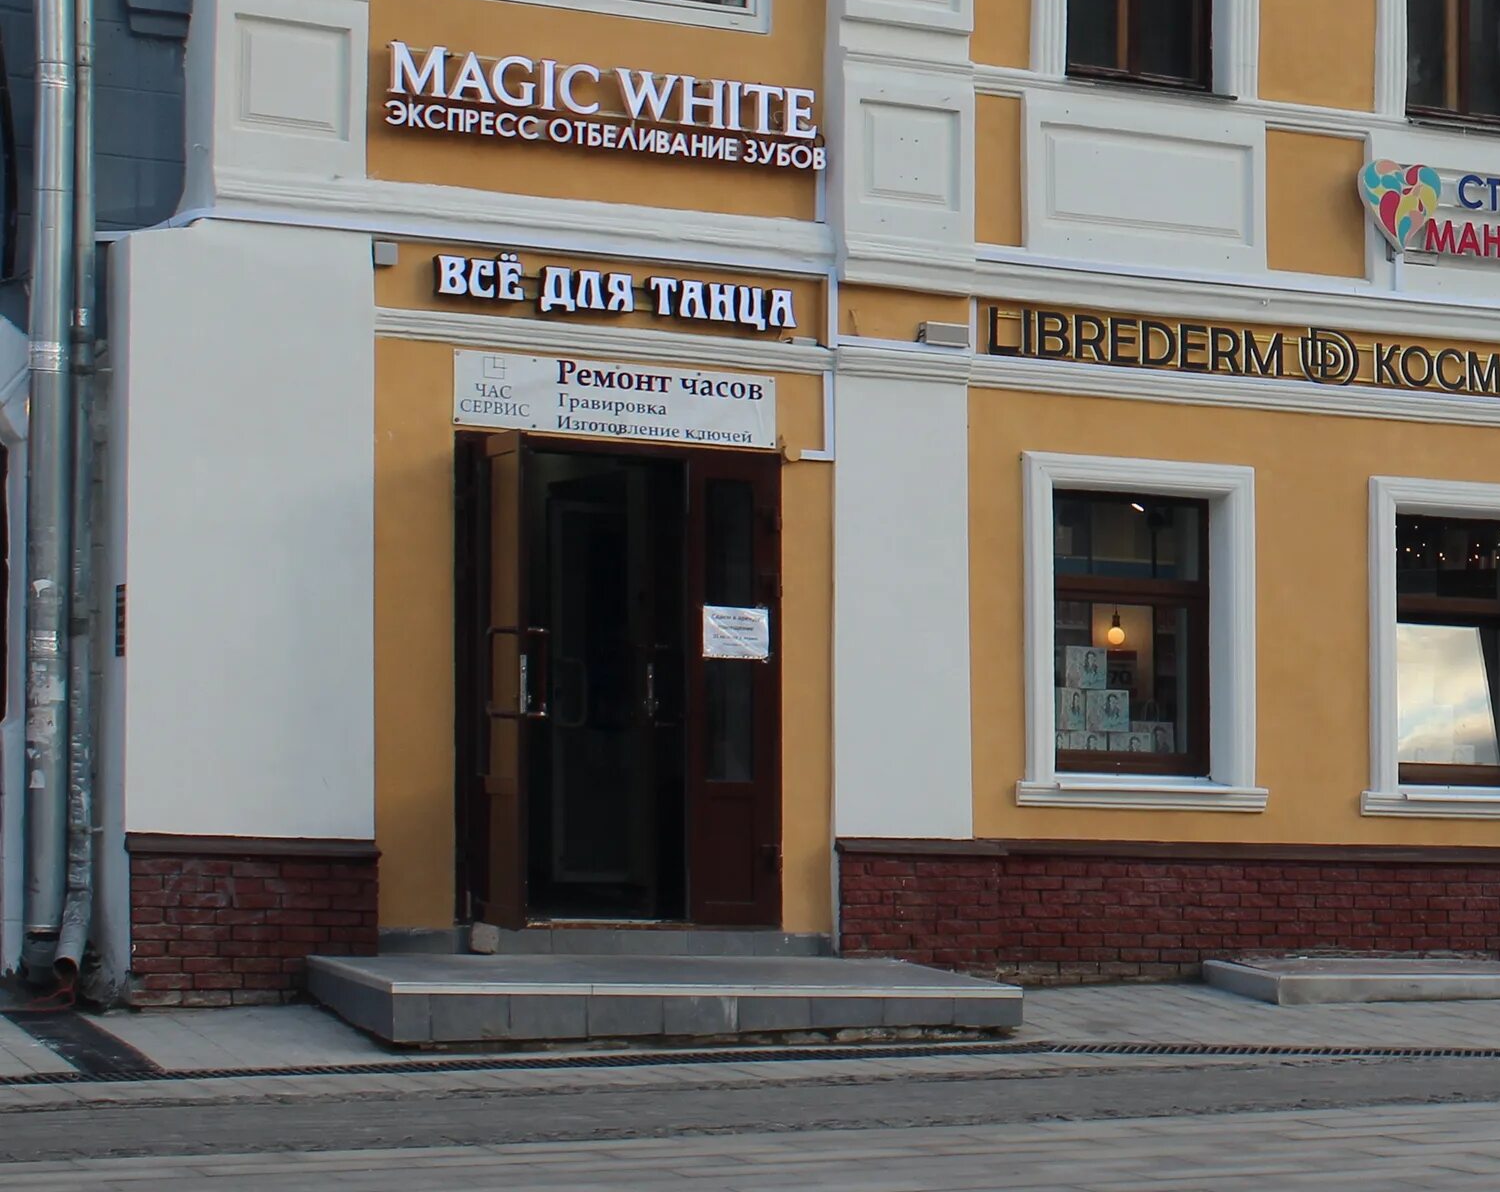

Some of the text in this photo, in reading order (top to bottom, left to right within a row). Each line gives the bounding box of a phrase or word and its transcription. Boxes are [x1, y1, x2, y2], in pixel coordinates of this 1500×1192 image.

[387, 40, 818, 139] MAGIC WHITE
[385, 100, 827, 170] ЭКСПРЕСС ОТБЕЛИВАНИЕ ЗУБОВ
[437, 253, 798, 331] ВСЁ ДЛЯ ТАНЦА
[986, 306, 1284, 378] LIBREDERM
[475, 382, 512, 400] ЧАС
[556, 359, 764, 401] Ремонт часов
[460, 399, 529, 418] СЕРВИС
[558, 392, 668, 417] Гравировка
[557, 414, 753, 445] Изготовление ключей
